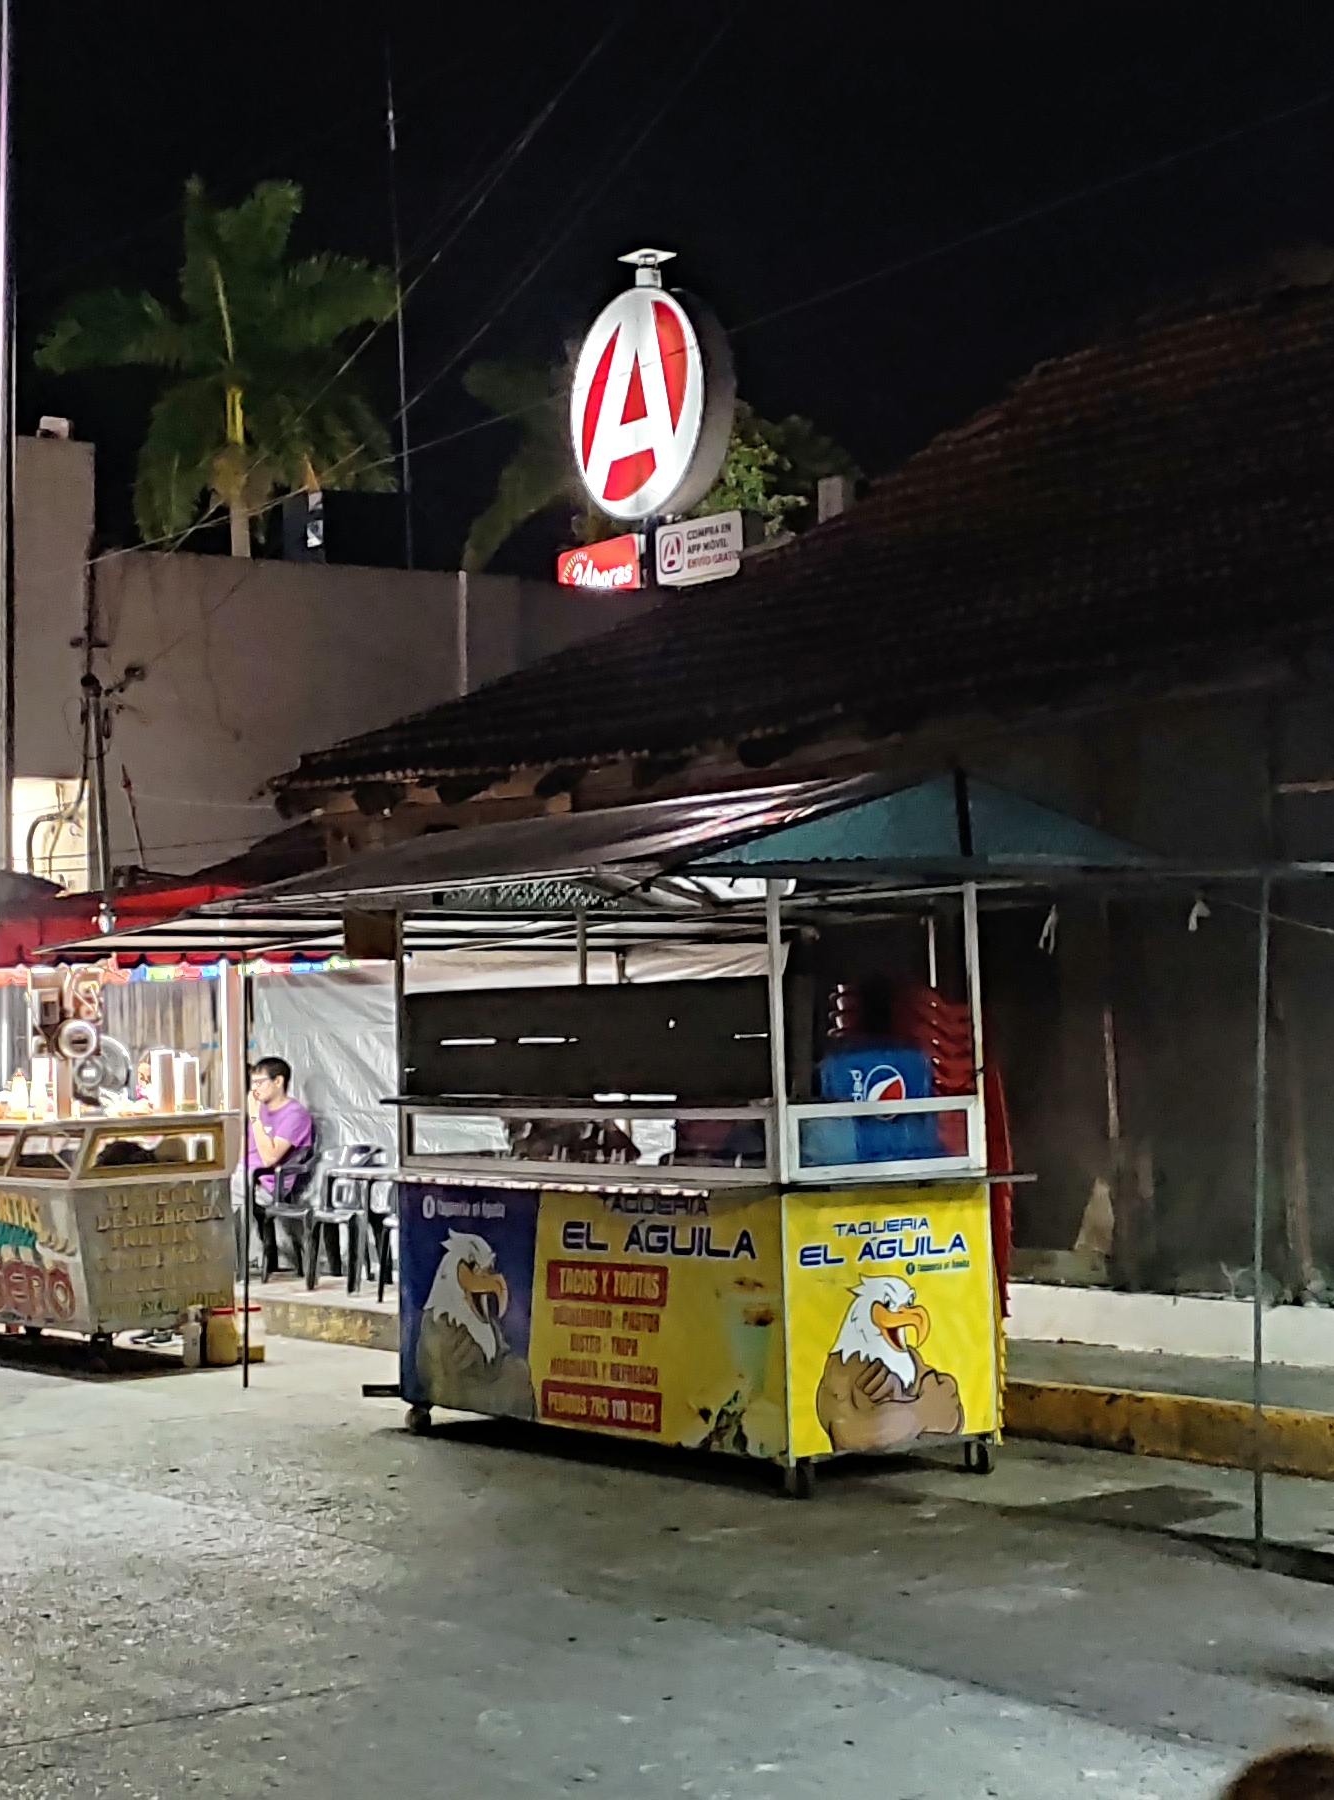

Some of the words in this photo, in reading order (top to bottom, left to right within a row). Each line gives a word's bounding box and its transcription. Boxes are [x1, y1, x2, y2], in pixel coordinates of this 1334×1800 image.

[687, 526, 719, 541] COMPRA
[721, 522, 732, 534] EN
[687, 542, 701, 555] APP
[562, 1220, 609, 1251] EL
[623, 1218, 757, 1260] ÁGUILA
[833, 1217, 930, 1237] TAQUERIA
[799, 1244, 845, 1267] EL
[857, 1233, 967, 1263] ÁGUILA
[559, 1267, 598, 1295] TACOS
[601, 1270, 610, 1295] Y
[613, 1271, 661, 1300] TORTAS
